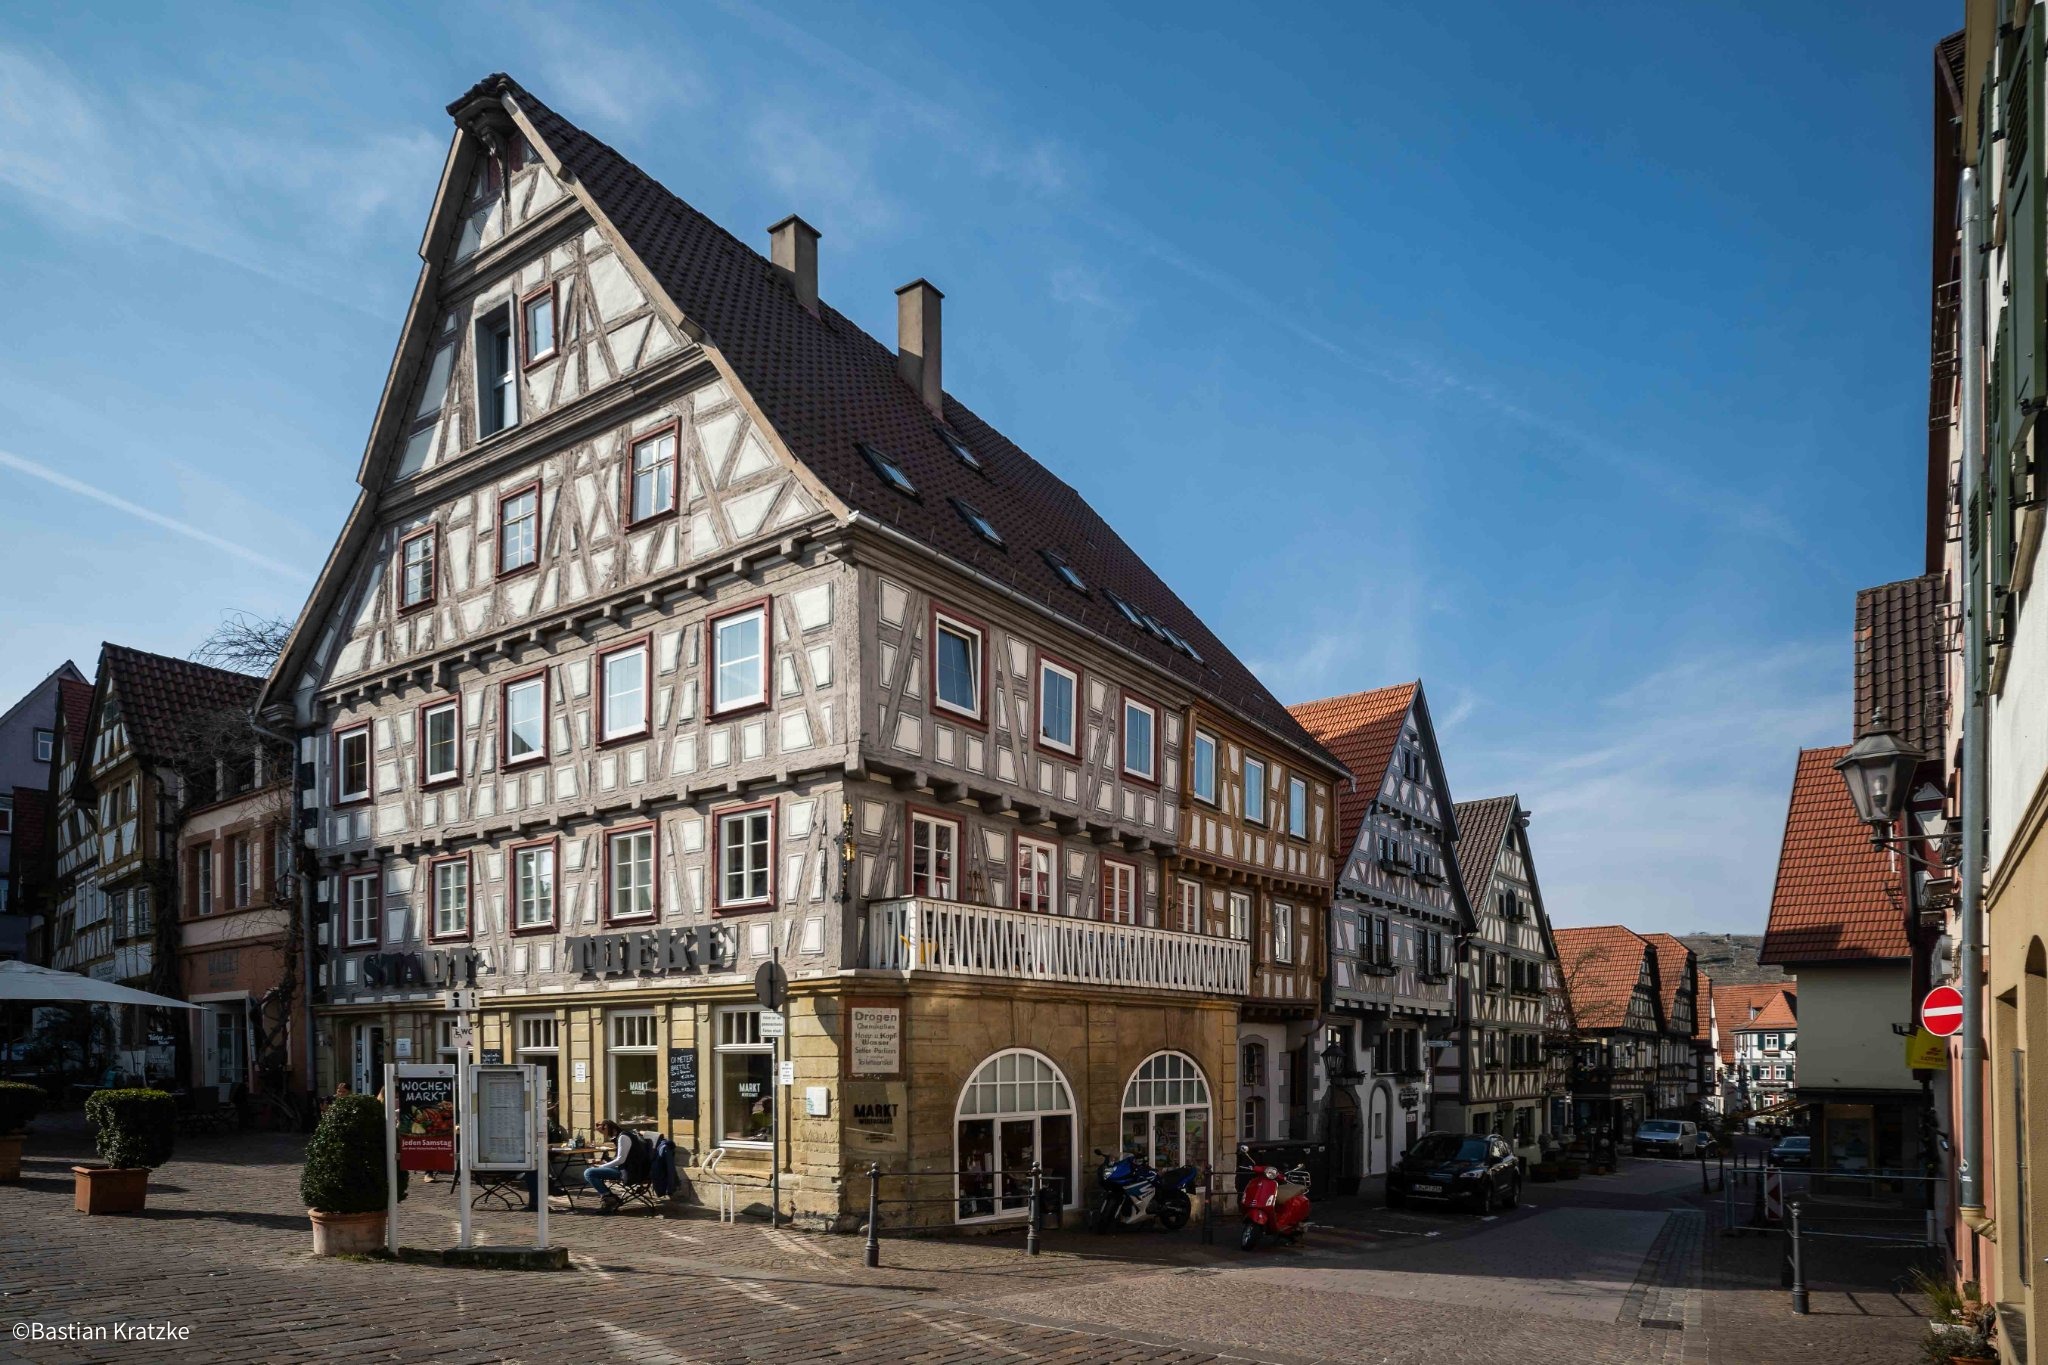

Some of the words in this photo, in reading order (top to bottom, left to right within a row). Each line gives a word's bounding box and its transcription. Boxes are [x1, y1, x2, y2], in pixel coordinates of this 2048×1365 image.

[364, 946, 476, 988] STADT
[565, 923, 725, 974] THEKE
[854, 1011, 897, 1024] Drogen
[401, 1081, 451, 1091] WOCHEN
[629, 1081, 648, 1091] MARKT
[739, 1082, 761, 1093] MARKT
[405, 1091, 447, 1102] MARKT
[854, 1104, 899, 1117] MARKT
[422, 1139, 452, 1147] Samstag
